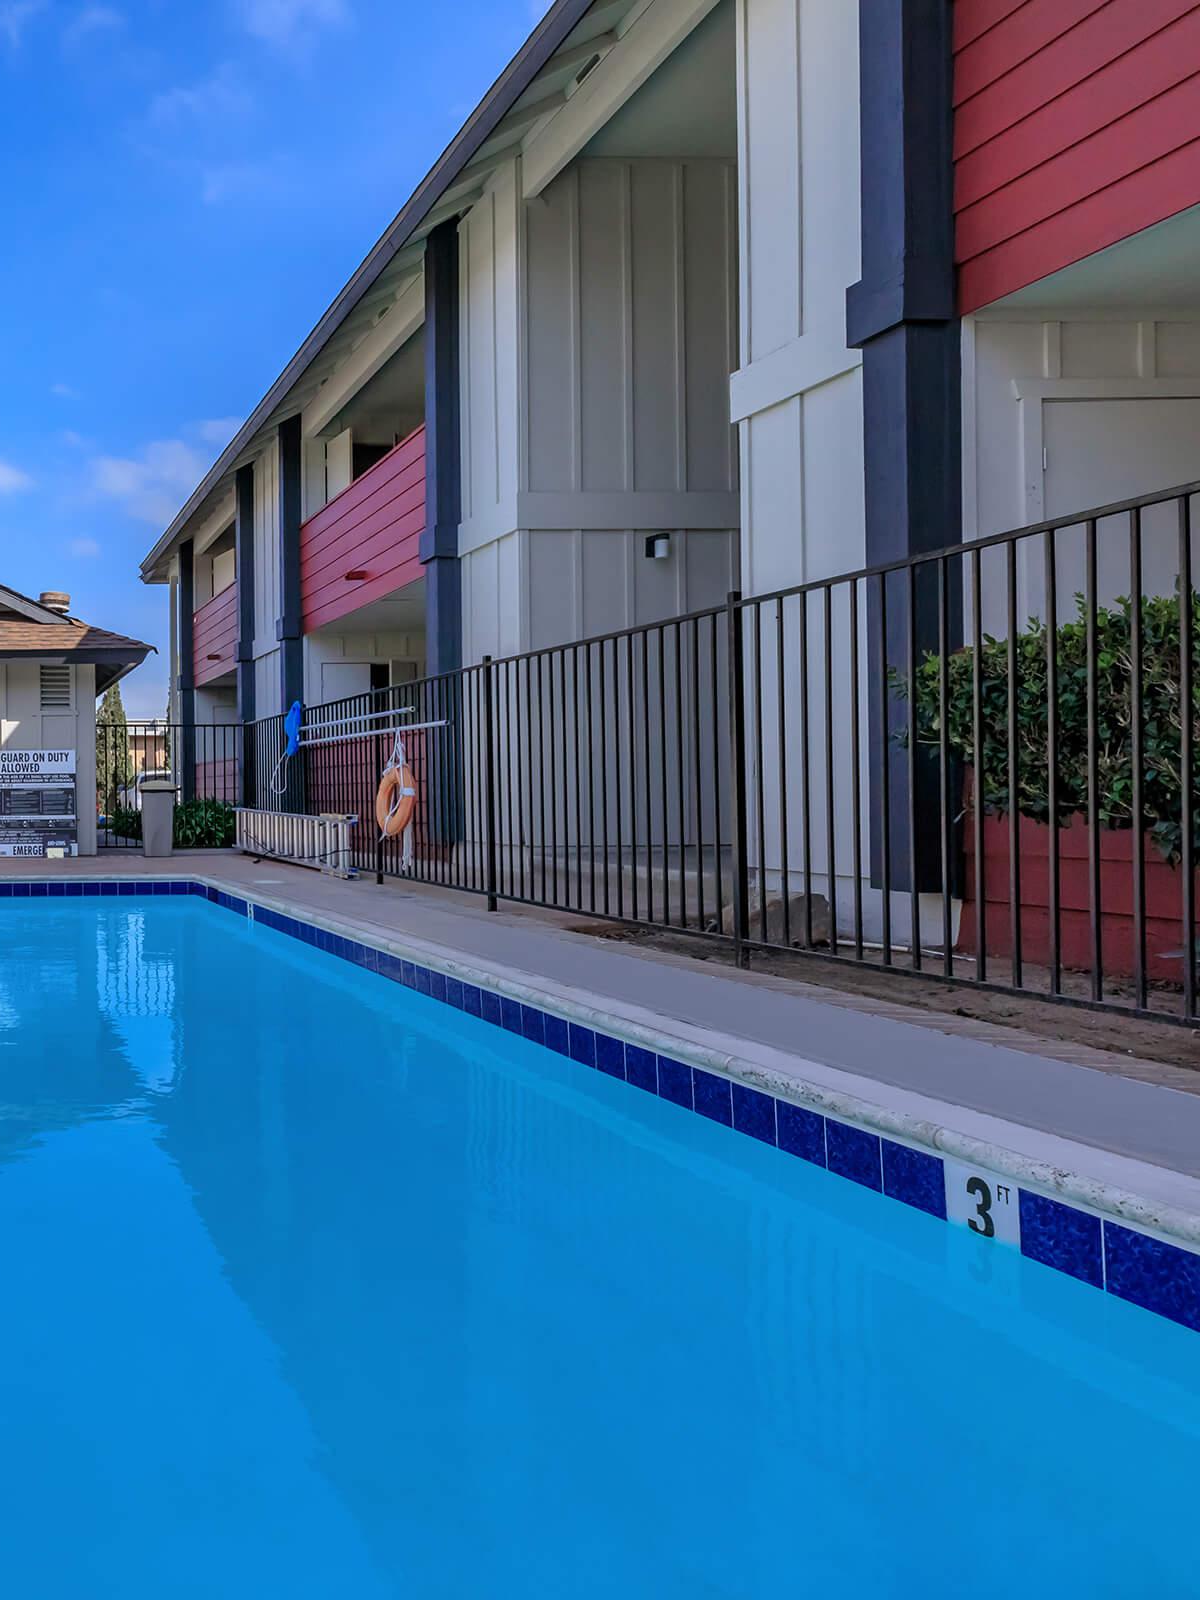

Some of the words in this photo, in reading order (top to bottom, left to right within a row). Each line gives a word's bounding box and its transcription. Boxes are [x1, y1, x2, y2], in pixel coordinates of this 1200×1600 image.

[32, 752, 45, 762] ON
[48, 752, 69, 762] DUTY
[1, 763, 40, 772] ALLOWED
[966, 1176, 994, 1238] 3
[997, 1184, 1010, 1204] FT
